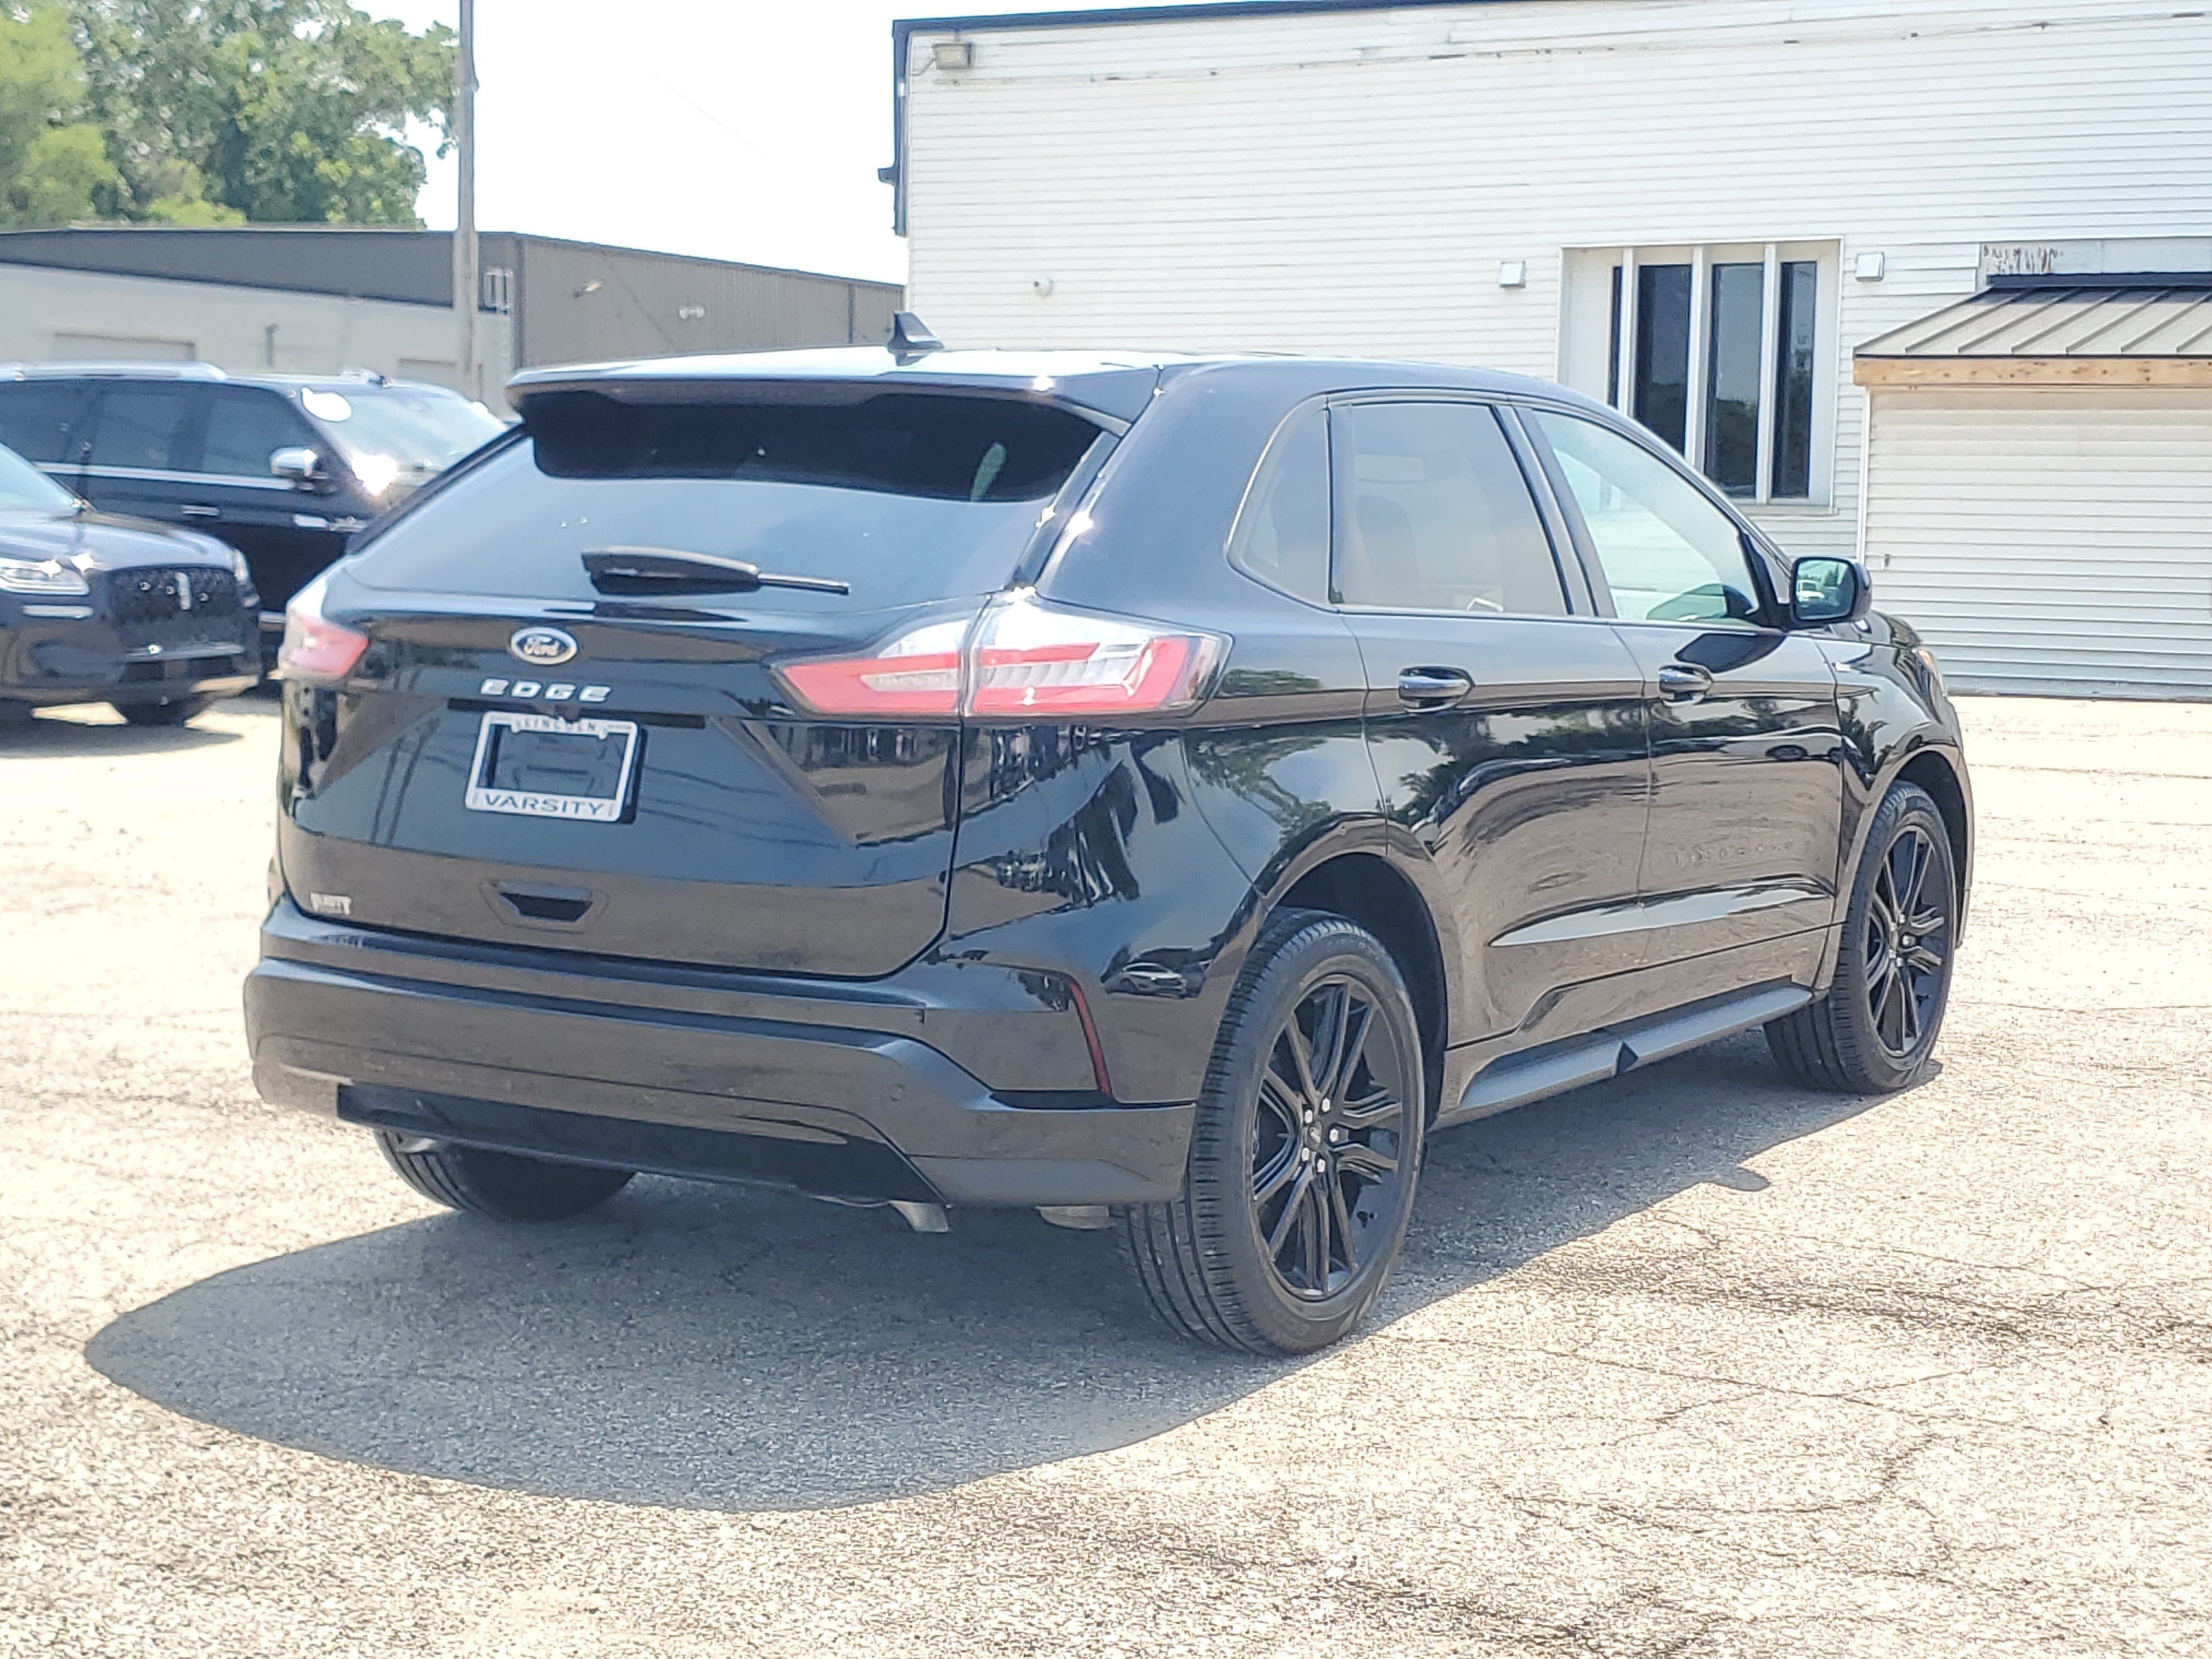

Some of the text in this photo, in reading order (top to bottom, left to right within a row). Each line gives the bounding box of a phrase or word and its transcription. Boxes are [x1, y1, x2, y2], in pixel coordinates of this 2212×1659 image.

[524, 636, 560, 656] Ford
[481, 679, 611, 702] EDGE
[485, 794, 604, 815] VARSITY
